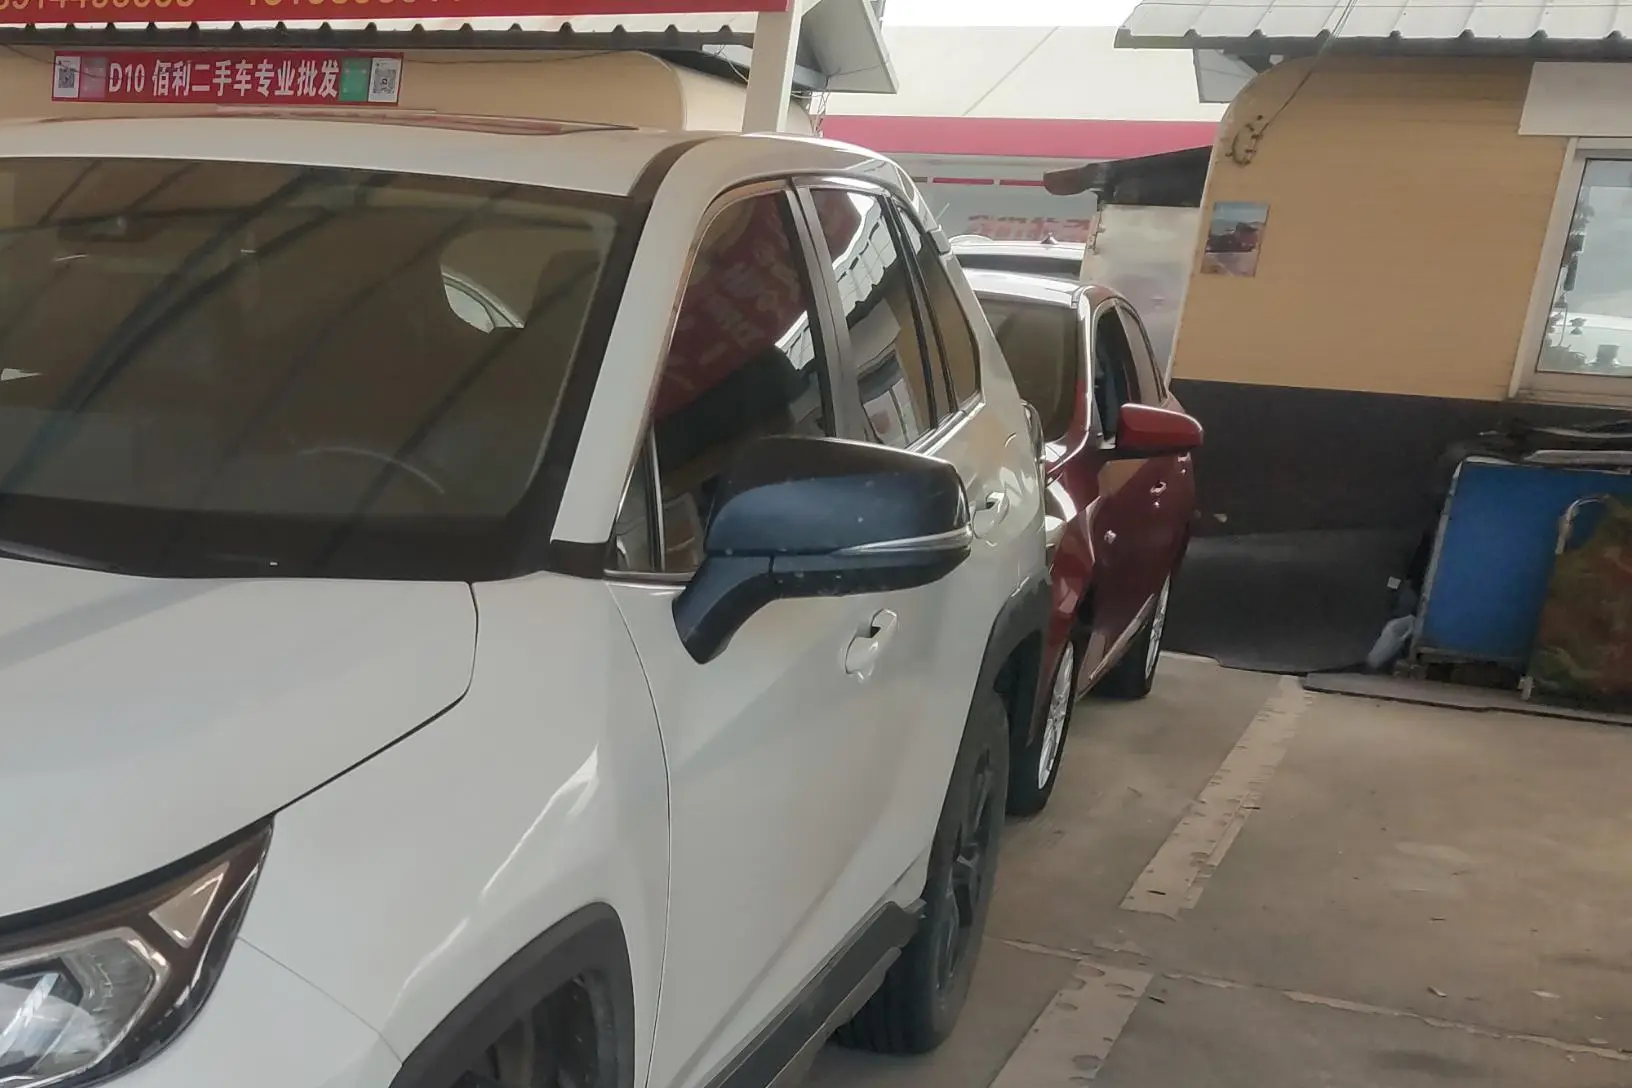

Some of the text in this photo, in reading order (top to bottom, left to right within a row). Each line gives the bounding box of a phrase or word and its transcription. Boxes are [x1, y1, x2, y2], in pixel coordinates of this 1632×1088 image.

[108, 59, 340, 98] D10 佰利二手车专业批发
